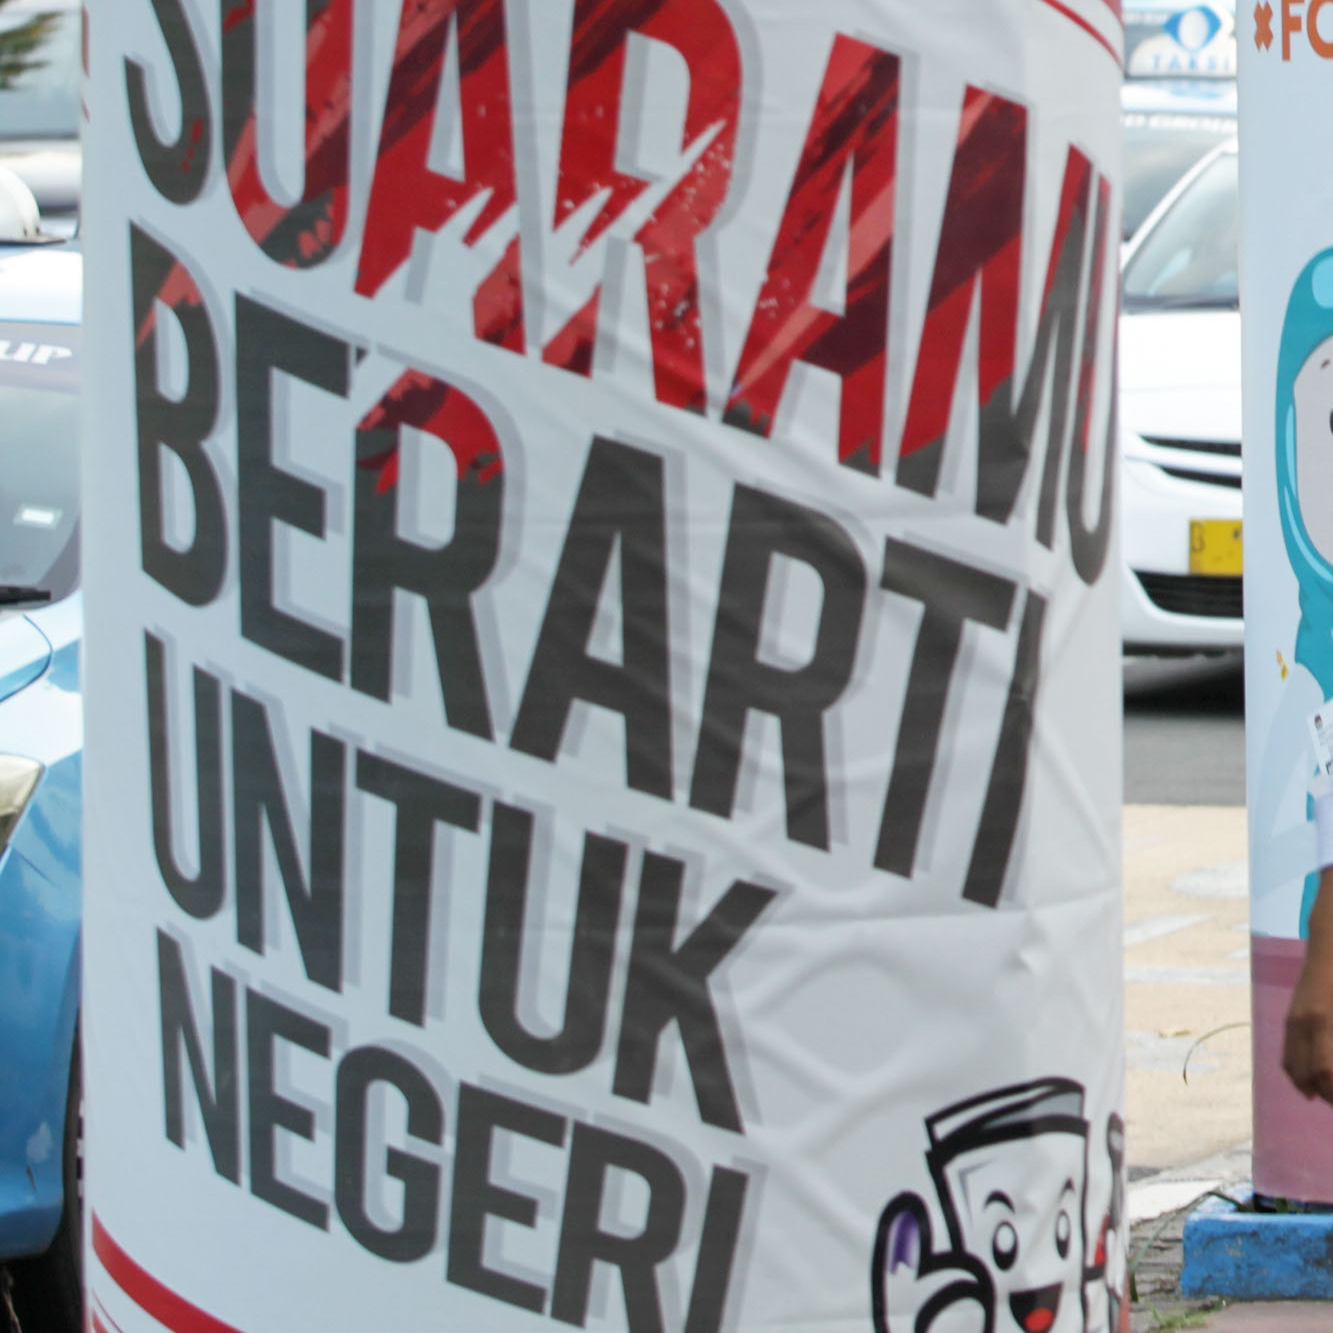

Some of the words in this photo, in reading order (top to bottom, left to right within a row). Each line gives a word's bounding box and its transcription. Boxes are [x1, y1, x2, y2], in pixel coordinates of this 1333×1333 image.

[128, 219, 1047, 909] BERARTI
[144, 628, 780, 1136] UNTUK
[155, 927, 751, 1333] NEGERI
